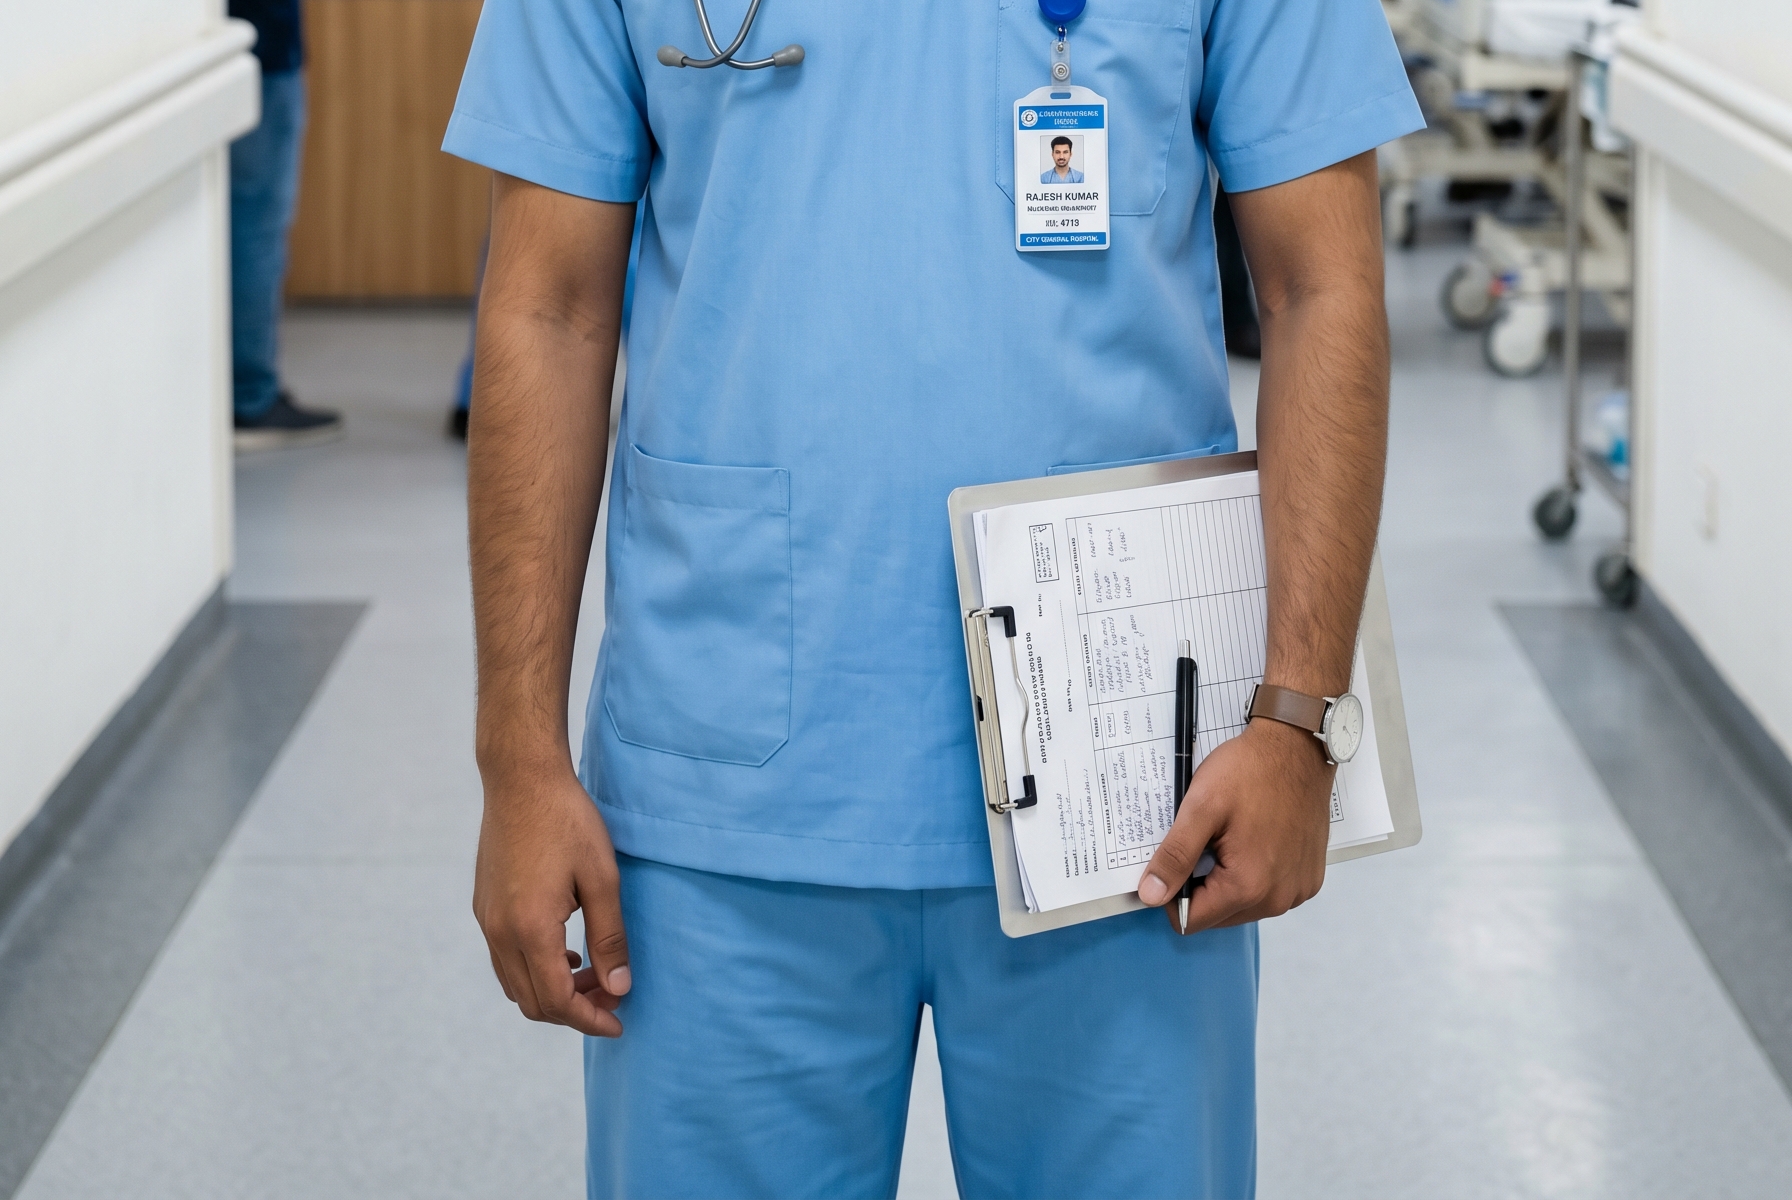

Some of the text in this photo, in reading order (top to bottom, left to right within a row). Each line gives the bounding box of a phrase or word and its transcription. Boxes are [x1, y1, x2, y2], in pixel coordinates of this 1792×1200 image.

[1026, 192, 1099, 201] RAJESH KUMAR
[1060, 219, 1079, 227] 4713
